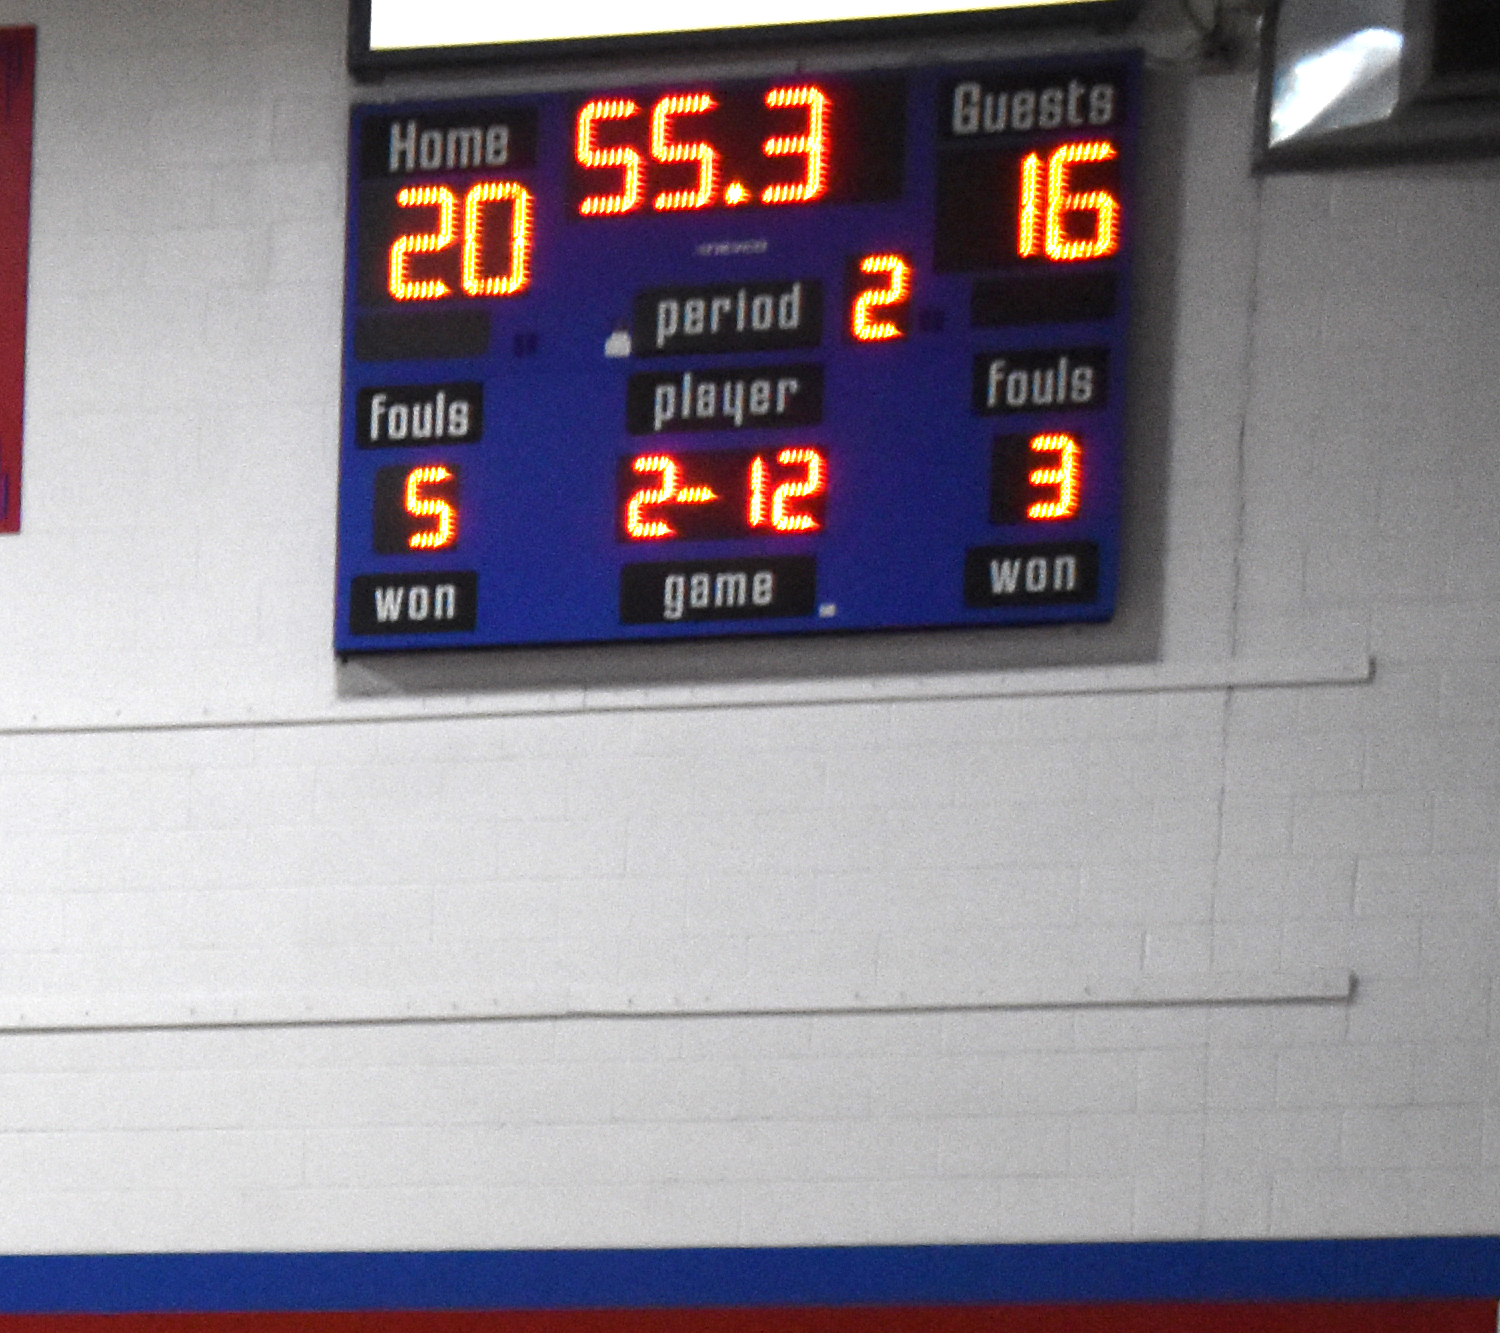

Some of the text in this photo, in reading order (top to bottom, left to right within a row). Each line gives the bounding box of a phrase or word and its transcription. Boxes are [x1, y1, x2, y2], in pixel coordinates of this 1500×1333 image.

[951, 77, 1114, 133] Guests
[388, 119, 509, 171] Home
[575, 84, 831, 217] 55.3
[1018, 141, 1119, 262] 16
[389, 181, 533, 302] 20
[655, 283, 804, 340] period
[850, 254, 911, 342] 2
[653, 372, 799, 430] player
[987, 358, 1095, 409] fouls
[371, 392, 470, 441] fouls
[1026, 432, 1080, 520] 3
[404, 465, 457, 550] 5
[374, 583, 456, 624] won
[663, 565, 775, 621] game
[990, 554, 1079, 596] won
